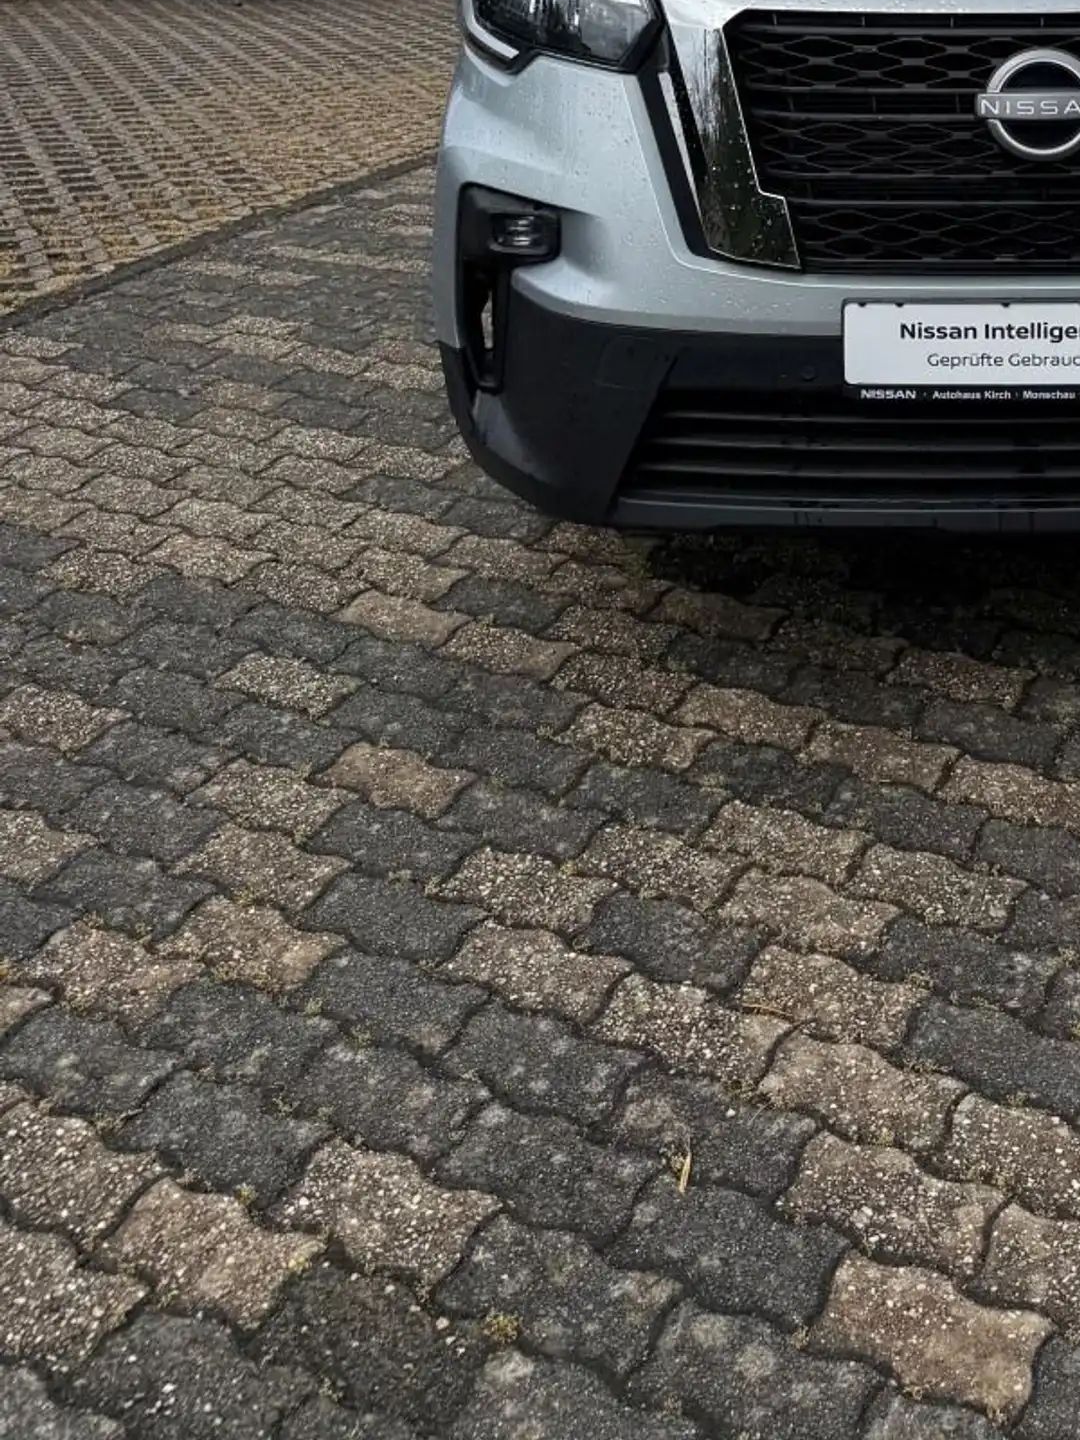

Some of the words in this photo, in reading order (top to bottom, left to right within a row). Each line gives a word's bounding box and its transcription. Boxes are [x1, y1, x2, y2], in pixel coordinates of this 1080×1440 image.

[900, 322, 977, 340] Nissan
[927, 352, 1004, 370] Geprüfte
[860, 389, 916, 399] NISSAN
[932, 390, 981, 400] Autohaus
[984, 390, 1011, 399] Kirch
[1022, 390, 1076, 400] Monschau
